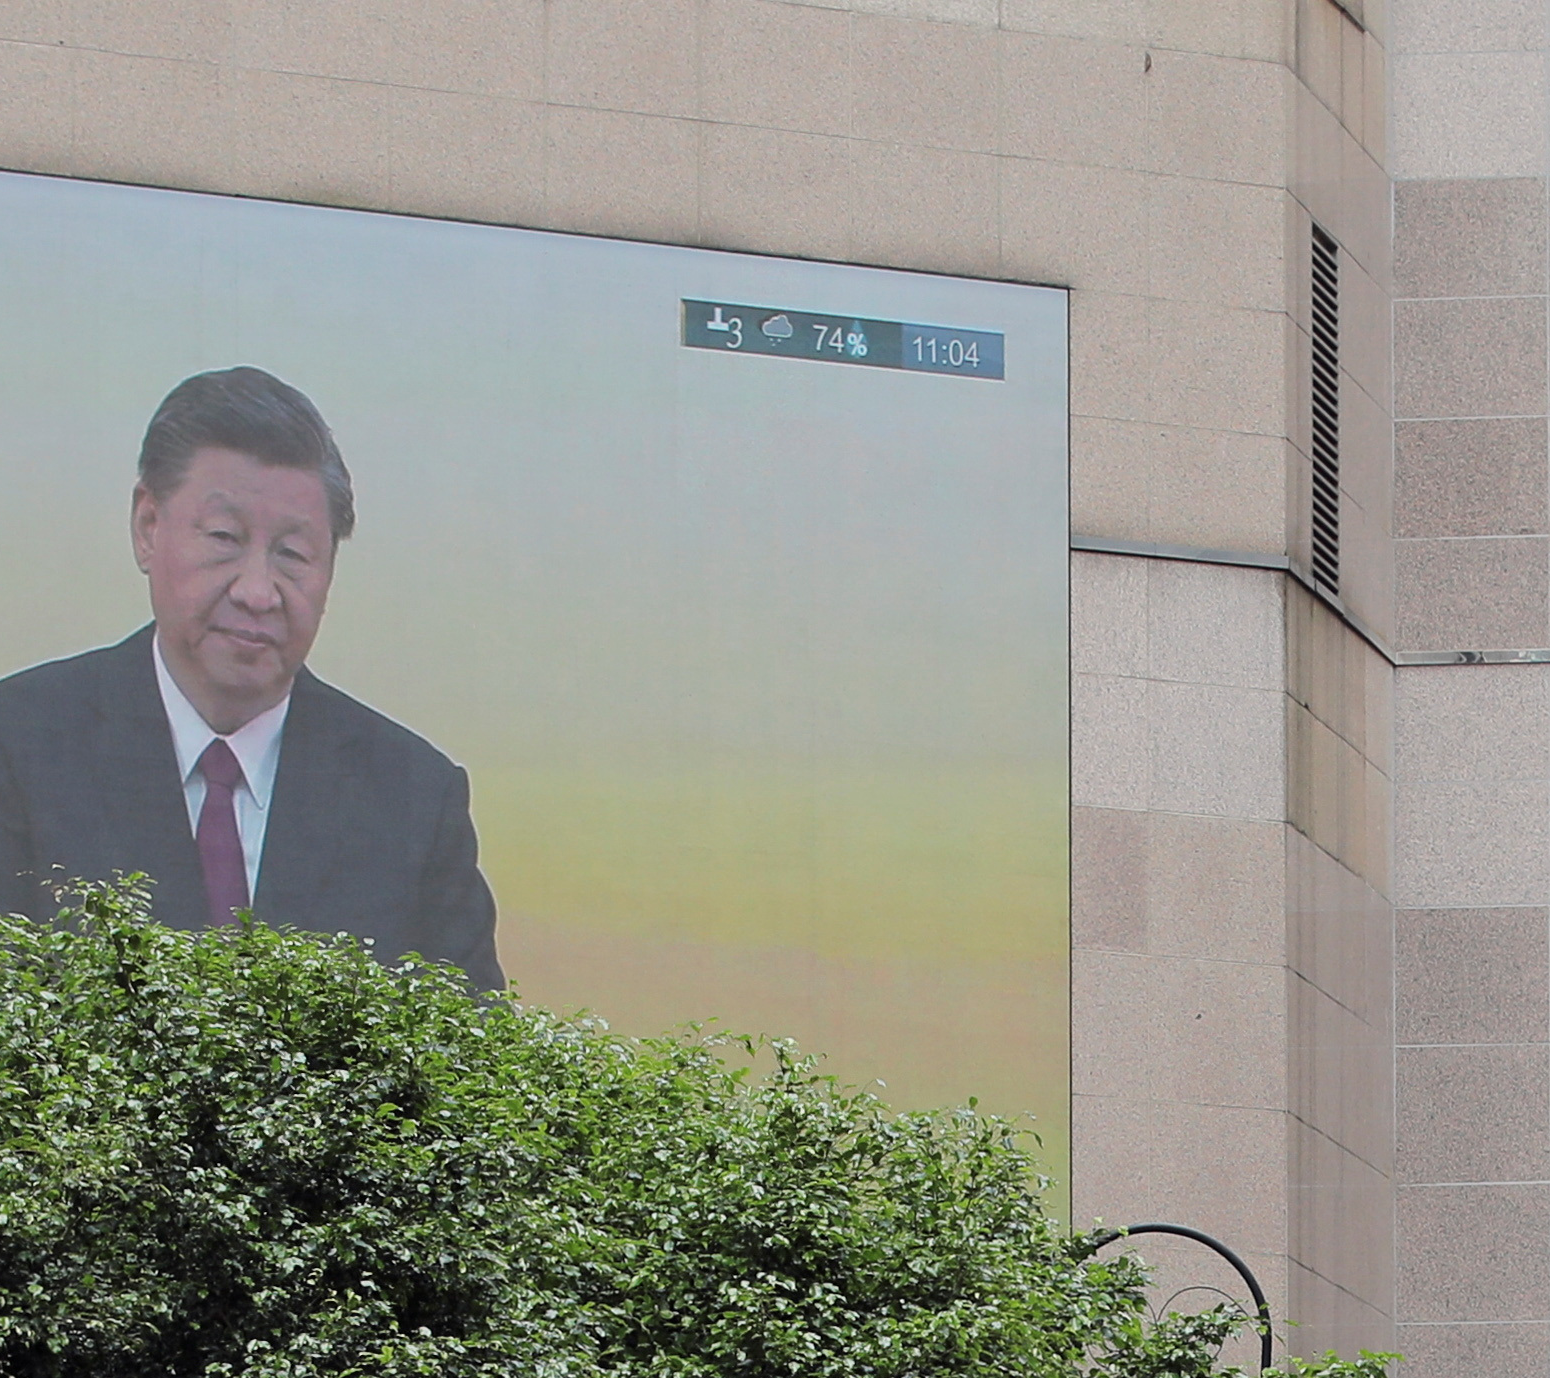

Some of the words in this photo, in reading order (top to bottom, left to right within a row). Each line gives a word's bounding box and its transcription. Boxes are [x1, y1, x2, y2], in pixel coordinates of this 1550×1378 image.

[725, 317, 744, 349] 3
[812, 323, 868, 357] 74%
[912, 336, 981, 368] 11:04
